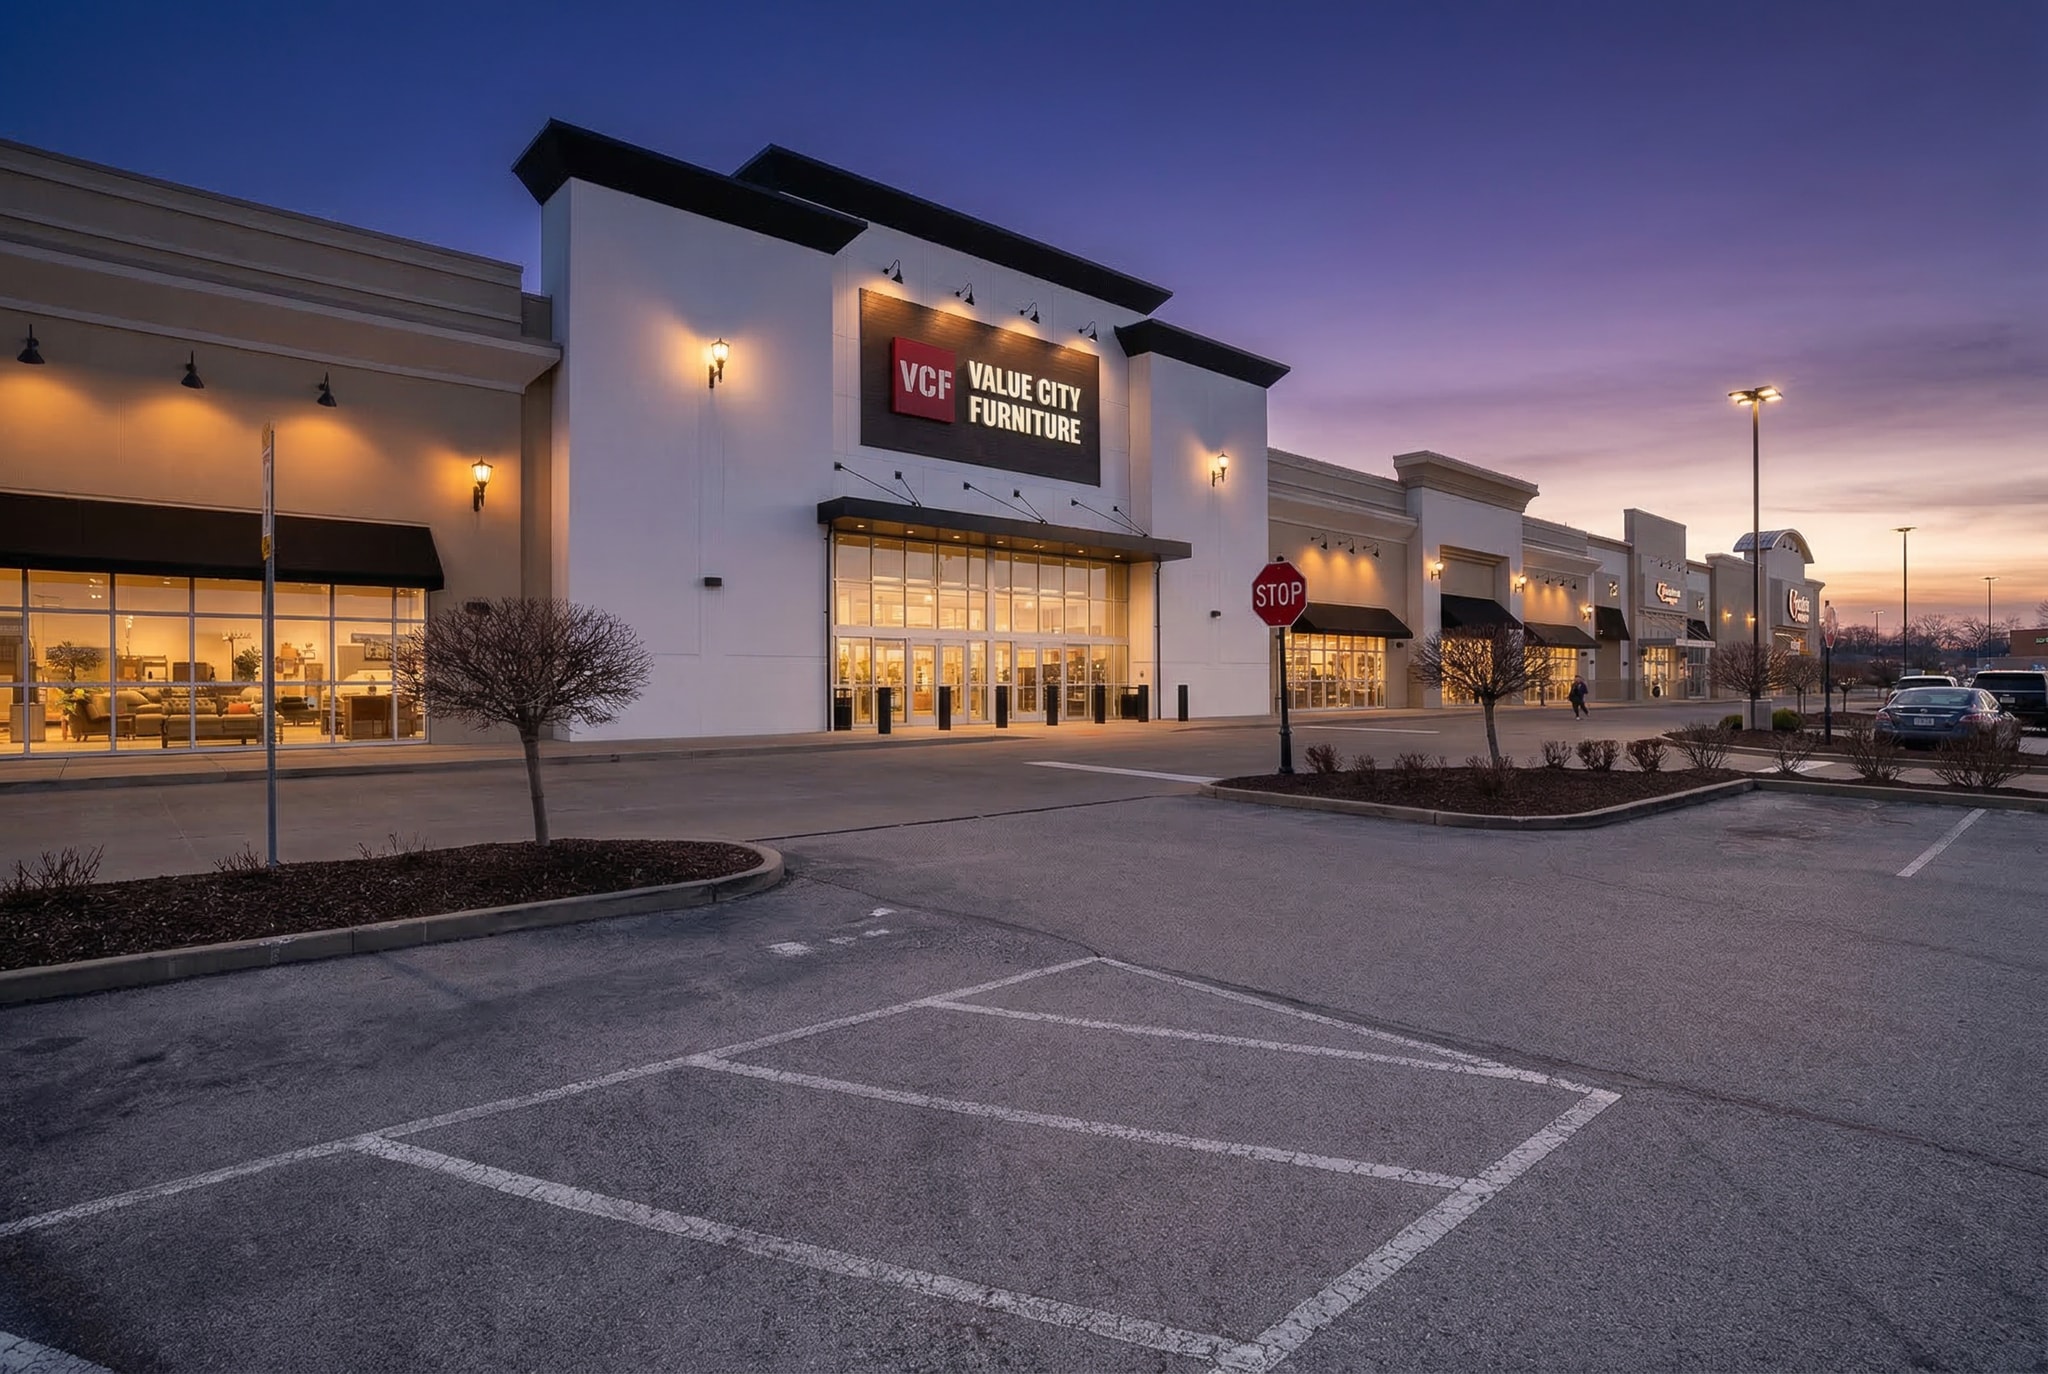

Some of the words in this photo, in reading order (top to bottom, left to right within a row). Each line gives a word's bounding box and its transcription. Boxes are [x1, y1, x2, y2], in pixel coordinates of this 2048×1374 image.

[899, 359, 952, 400] VCF
[968, 360, 1033, 402] VALUE
[1036, 378, 1082, 413] CITY
[968, 395, 1082, 445] FURNITURE
[1256, 581, 1302, 607] STOP
